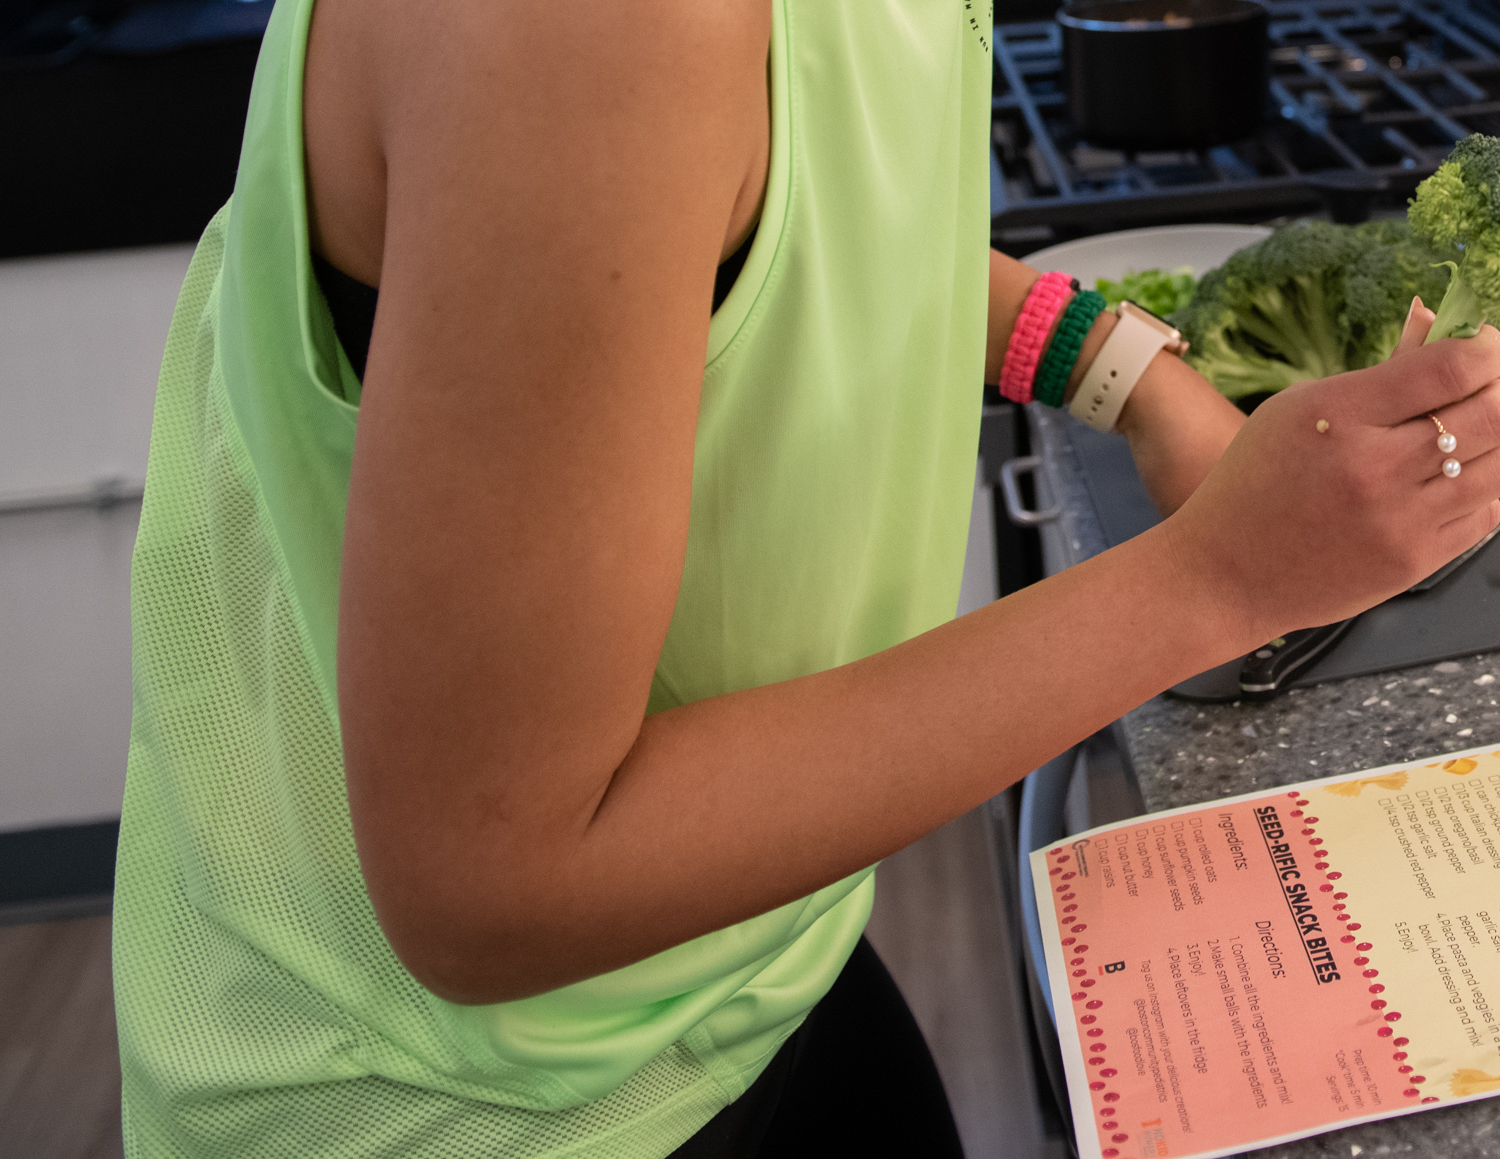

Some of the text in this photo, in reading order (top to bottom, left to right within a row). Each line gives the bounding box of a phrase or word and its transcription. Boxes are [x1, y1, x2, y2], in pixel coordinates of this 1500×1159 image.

[1216, 811, 1249, 871] Ingredients:
[1255, 804, 1342, 984] SEED-RIFIC SNACK BITES
[1454, 913, 1481, 948] pepper.
[1474, 909, 1498, 935] garlic
[1253, 919, 1287, 979] Directions:
[1445, 942, 1469, 968] pasta
[1103, 959, 1126, 974] B
[1229, 942, 1251, 983] Combine
[1214, 968, 1235, 995] small
[1241, 982, 1258, 995] all
[1416, 922, 1484, 1046] bowl. Add dressing and mix!
[1460, 967, 1481, 987] and
[1173, 977, 1193, 1018] leftovers
[1222, 992, 1241, 1018] balls
[1245, 993, 1261, 1012] the
[1469, 985, 1495, 1024] veggies
[1183, 1016, 1197, 1029] in
[1229, 1015, 1247, 1040] with
[1486, 1022, 1500, 1034] in
[1185, 1027, 1201, 1046] the
[1236, 1038, 1251, 1057] the
[1250, 1010, 1278, 1067] ingredients
[1124, 1026, 1147, 1077] @bosfoodlove
[1132, 997, 1168, 1104] @bostoncommunitypediatrics
[1190, 1044, 1208, 1074] fridge
[1240, 1056, 1268, 1109] ingredients
[1268, 1065, 1287, 1085] and
[1275, 1084, 1294, 1105] mix!
[1154, 1139, 1169, 1158] KID
